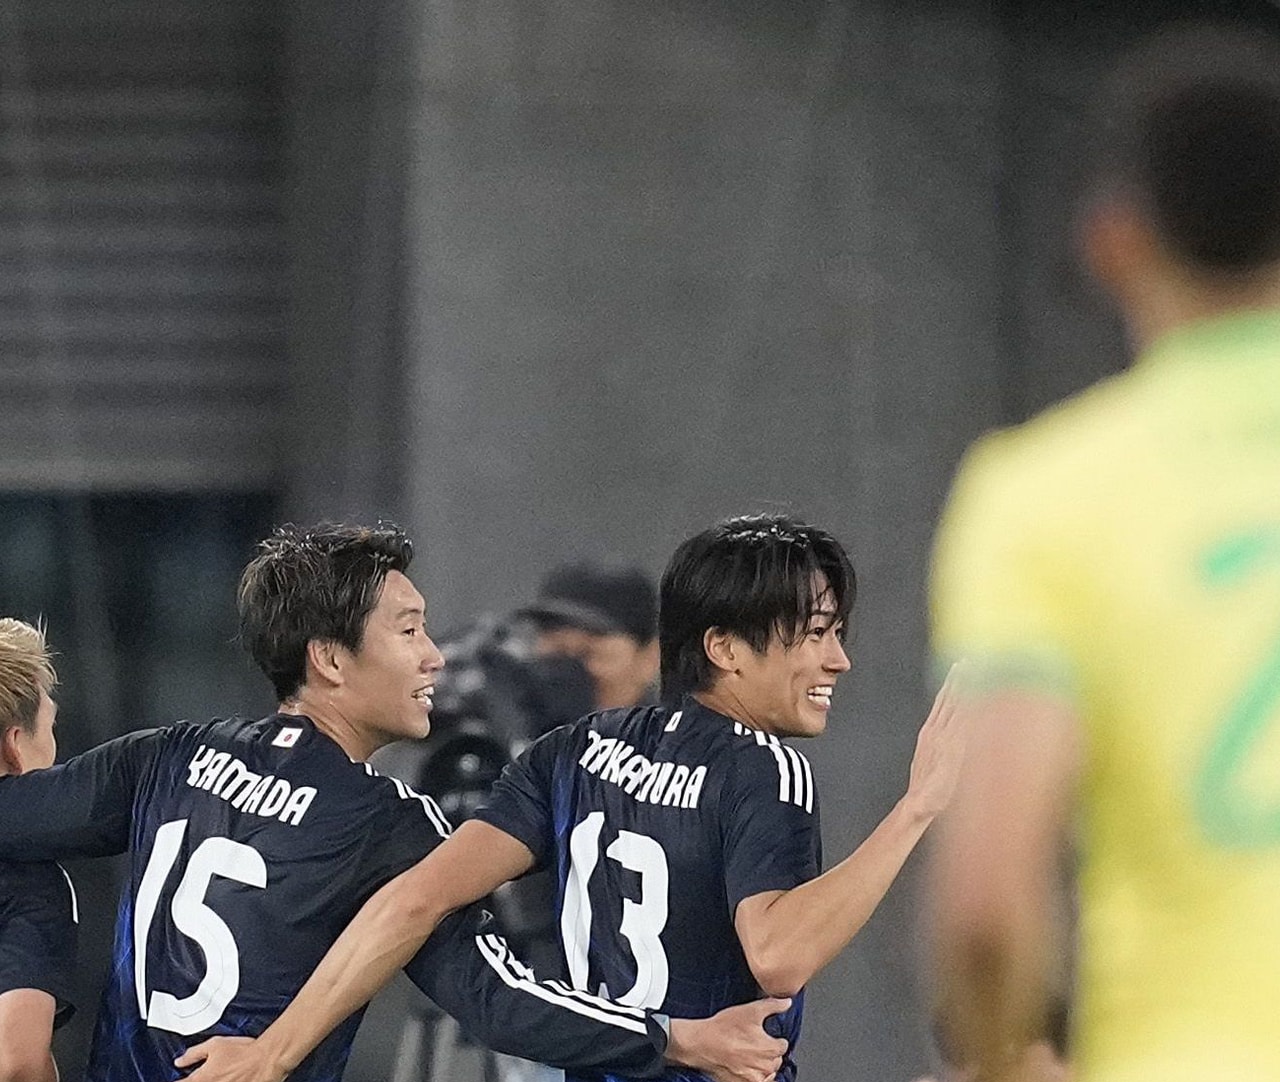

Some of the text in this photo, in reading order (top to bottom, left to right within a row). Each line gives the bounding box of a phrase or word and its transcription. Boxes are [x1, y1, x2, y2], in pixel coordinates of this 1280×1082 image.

[186, 744, 318, 826] KAMADA
[133, 818, 268, 1036] 15
[560, 811, 669, 1010] 13
